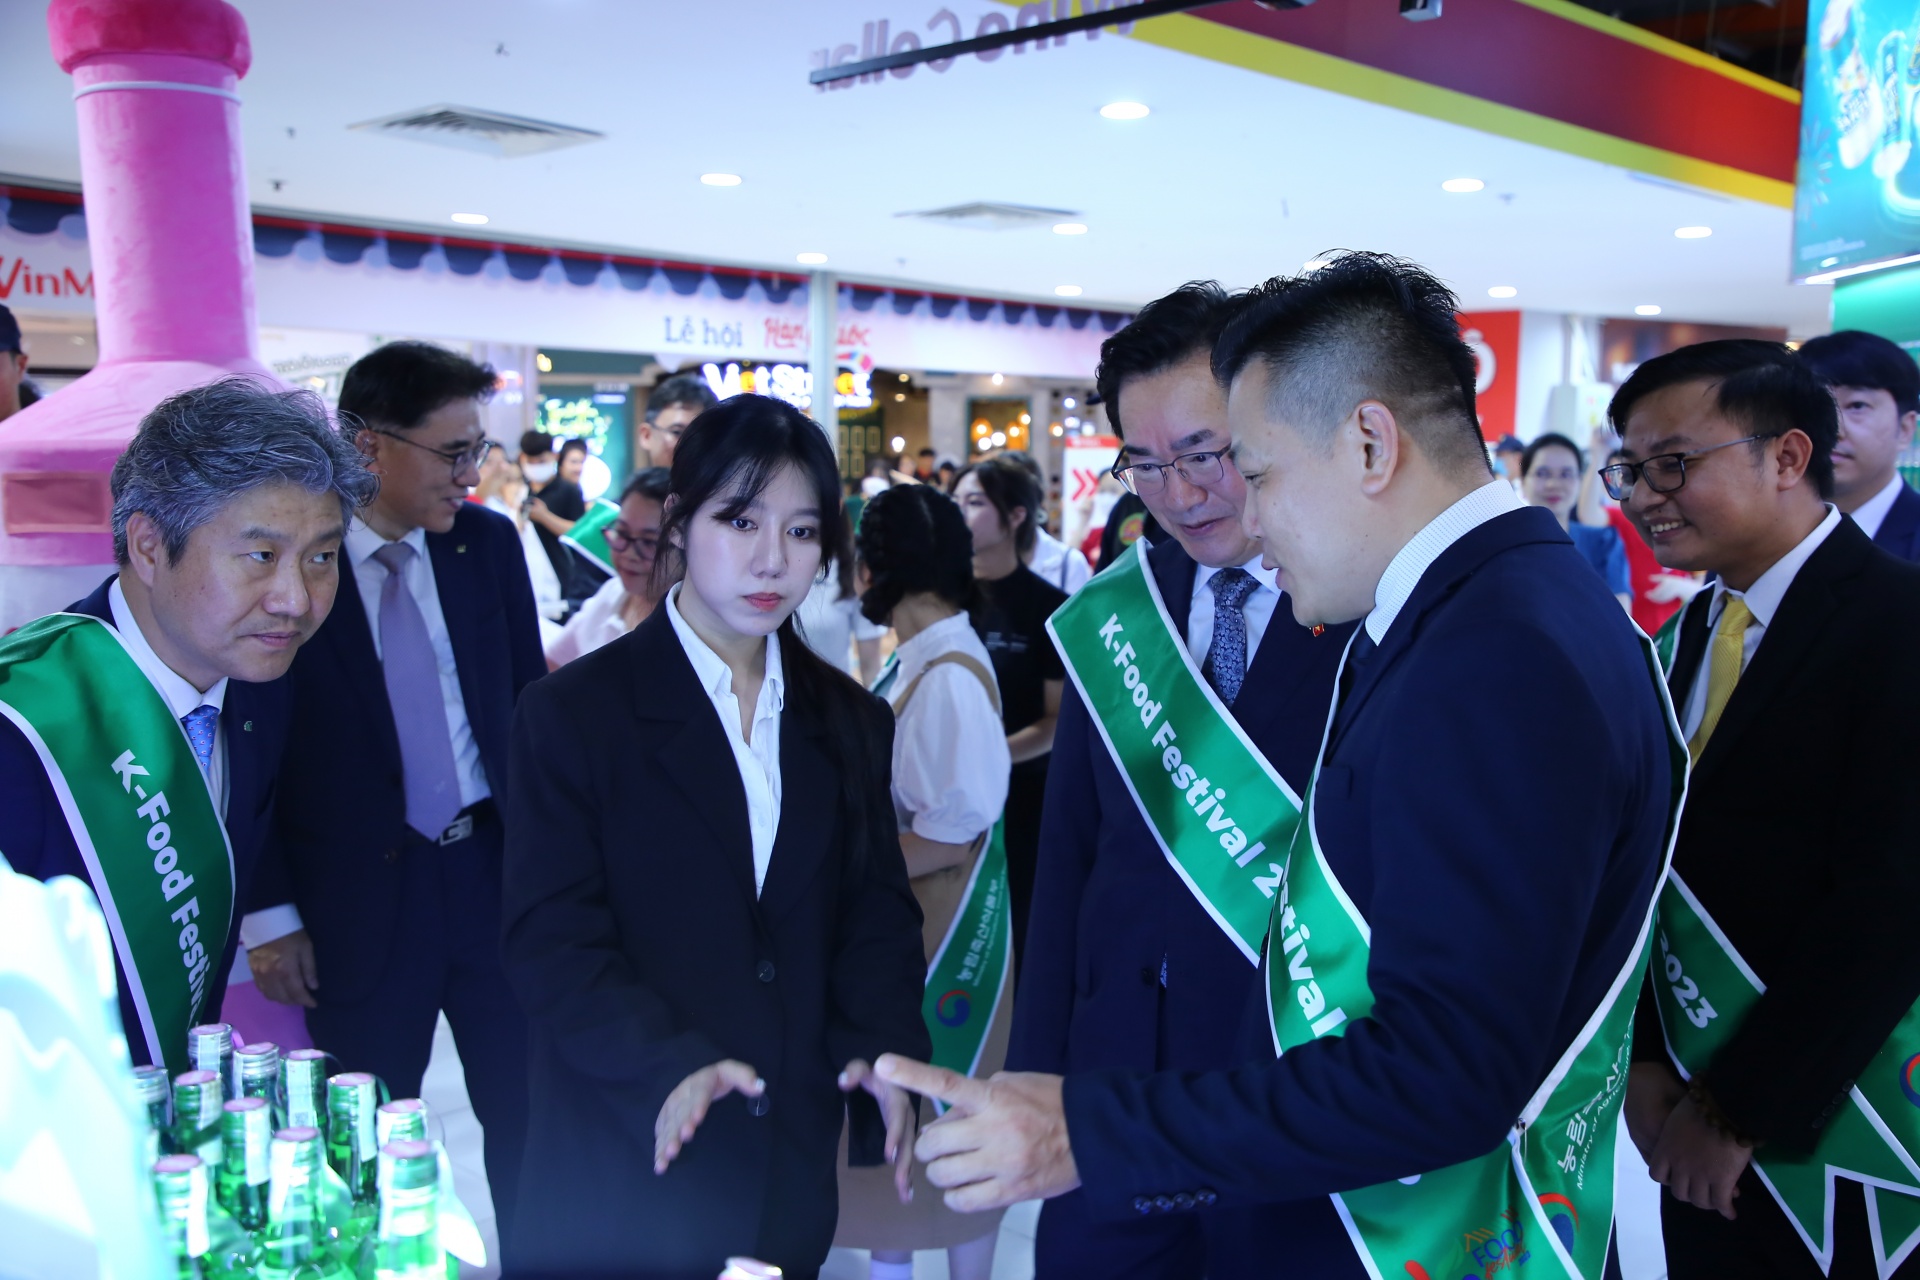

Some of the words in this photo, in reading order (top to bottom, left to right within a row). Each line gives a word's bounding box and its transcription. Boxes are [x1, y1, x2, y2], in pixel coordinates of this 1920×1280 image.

[1099, 613, 1163, 729] K-Food
[1151, 720, 1266, 868] Festival
[111, 748, 195, 902] K-Food
[1660, 928, 1719, 1029] 2023
[1576, 1138, 1594, 1191] Ministry
